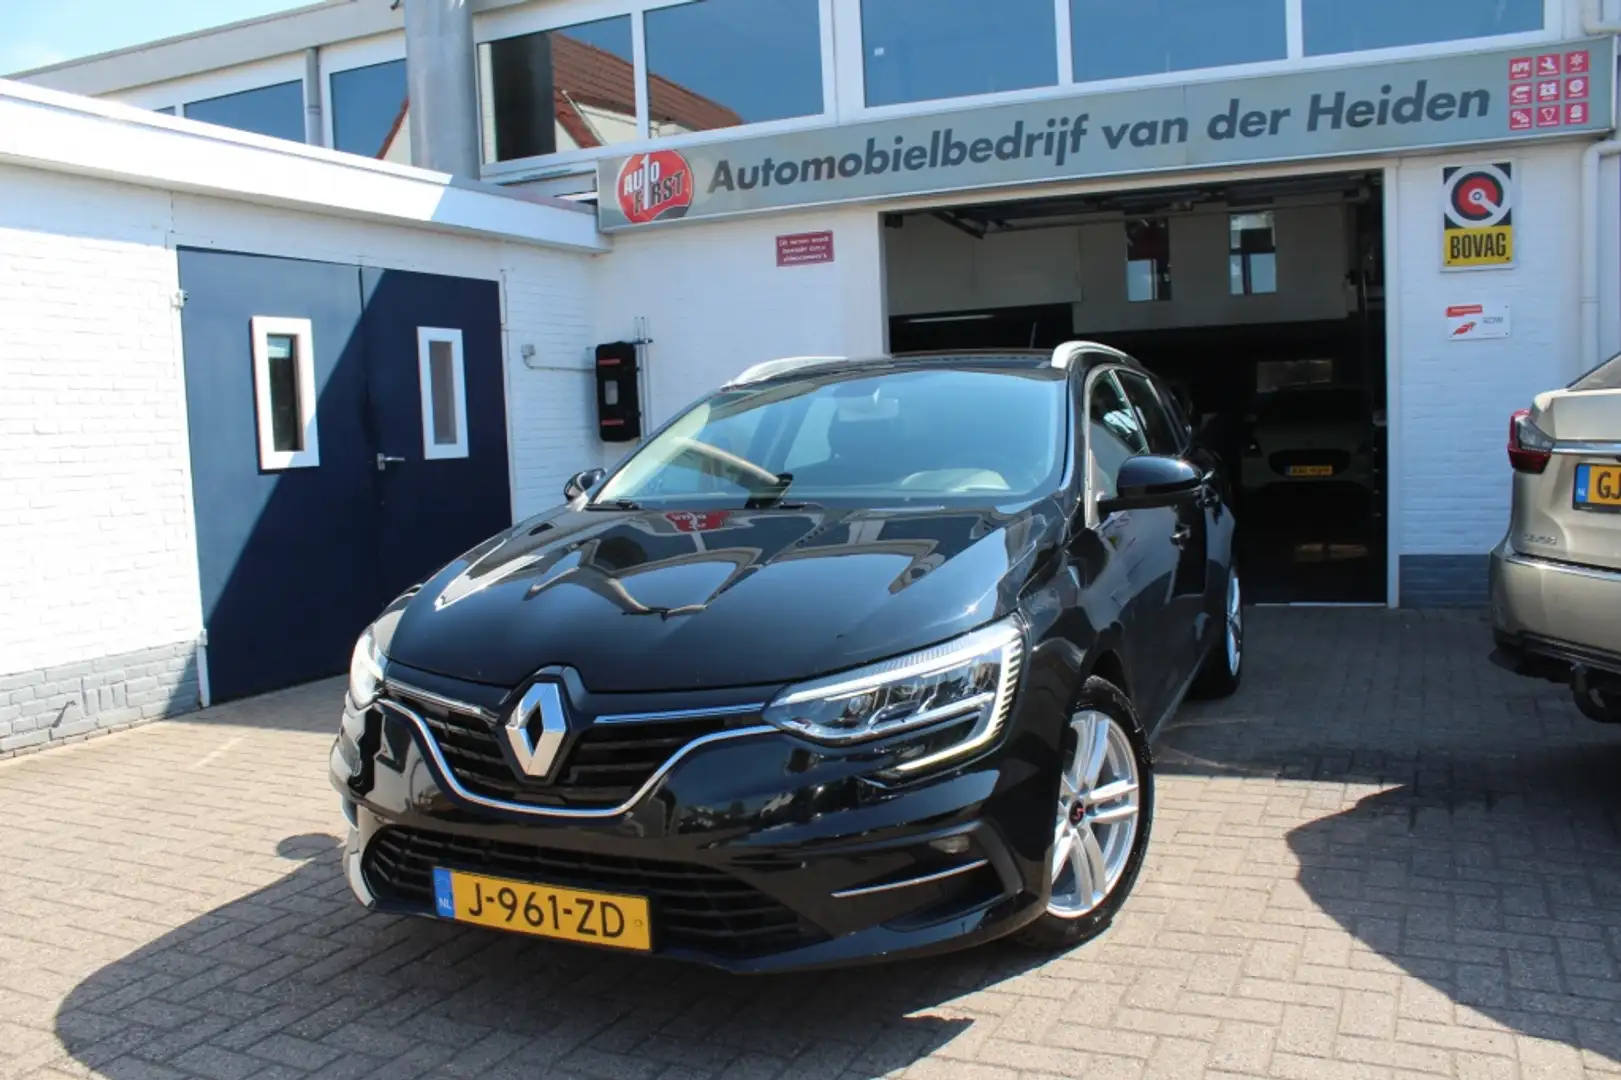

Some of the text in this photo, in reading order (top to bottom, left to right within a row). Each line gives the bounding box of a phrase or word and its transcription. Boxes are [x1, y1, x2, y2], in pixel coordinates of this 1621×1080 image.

[706, 79, 1491, 194] Automobielbedrijf van der Heiden
[1450, 232, 1507, 260] BOVAG
[438, 898, 452, 910] NL
[468, 883, 625, 938] J-961-ZD
